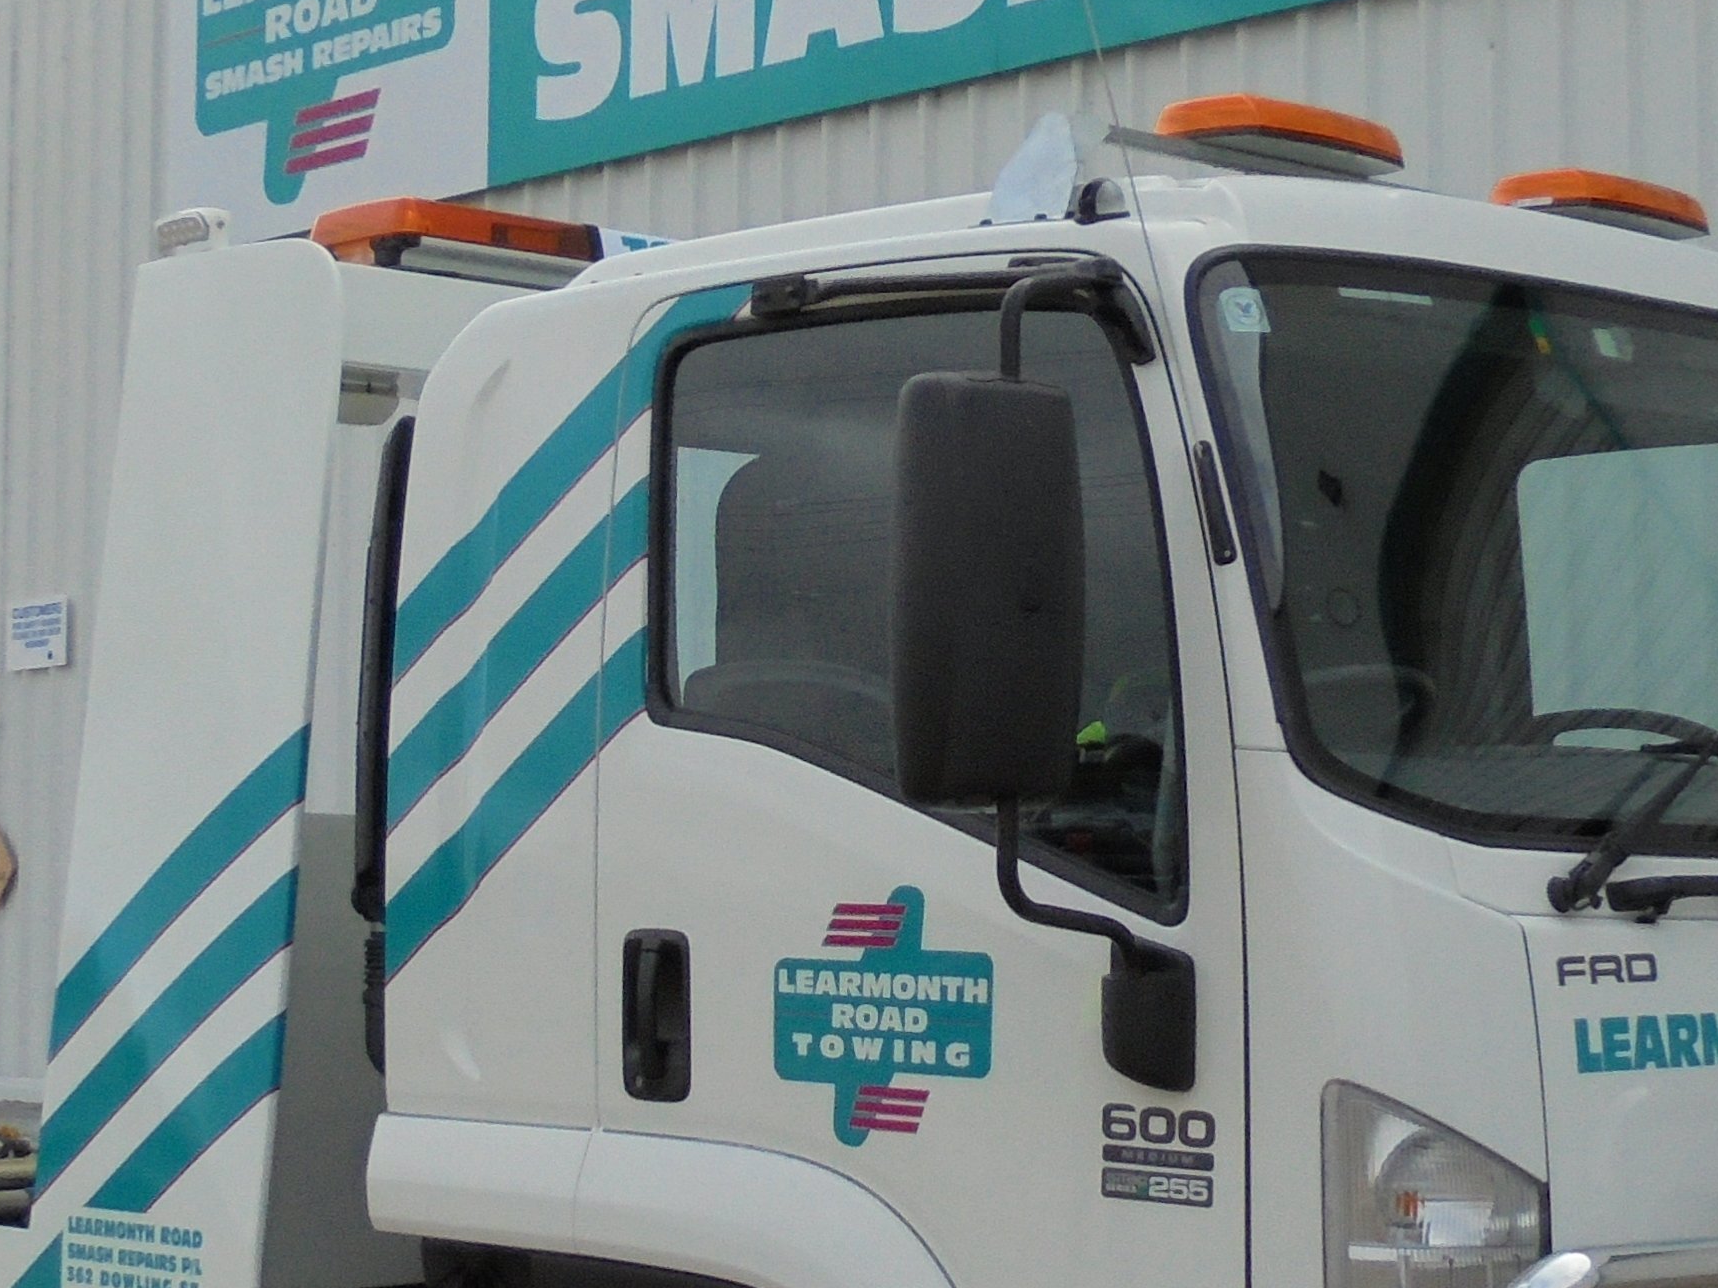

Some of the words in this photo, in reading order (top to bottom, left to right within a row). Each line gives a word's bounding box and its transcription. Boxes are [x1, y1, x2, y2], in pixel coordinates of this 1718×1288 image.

[204, 40, 303, 100] SMASH
[311, 7, 442, 70] REPAIRS
[778, 968, 988, 1004] LEARMONTH
[1556, 953, 1658, 986] FRD
[831, 1003, 928, 1033] ROAD
[791, 1032, 971, 1068] TOWING
[1102, 1103, 1216, 1148] 600
[1148, 1175, 1210, 1202] 255
[67, 1215, 155, 1244] LEARMONTH
[160, 1225, 203, 1248] ROAD
[67, 1242, 113, 1264] SMASH
[117, 1248, 177, 1273] REPAIRS
